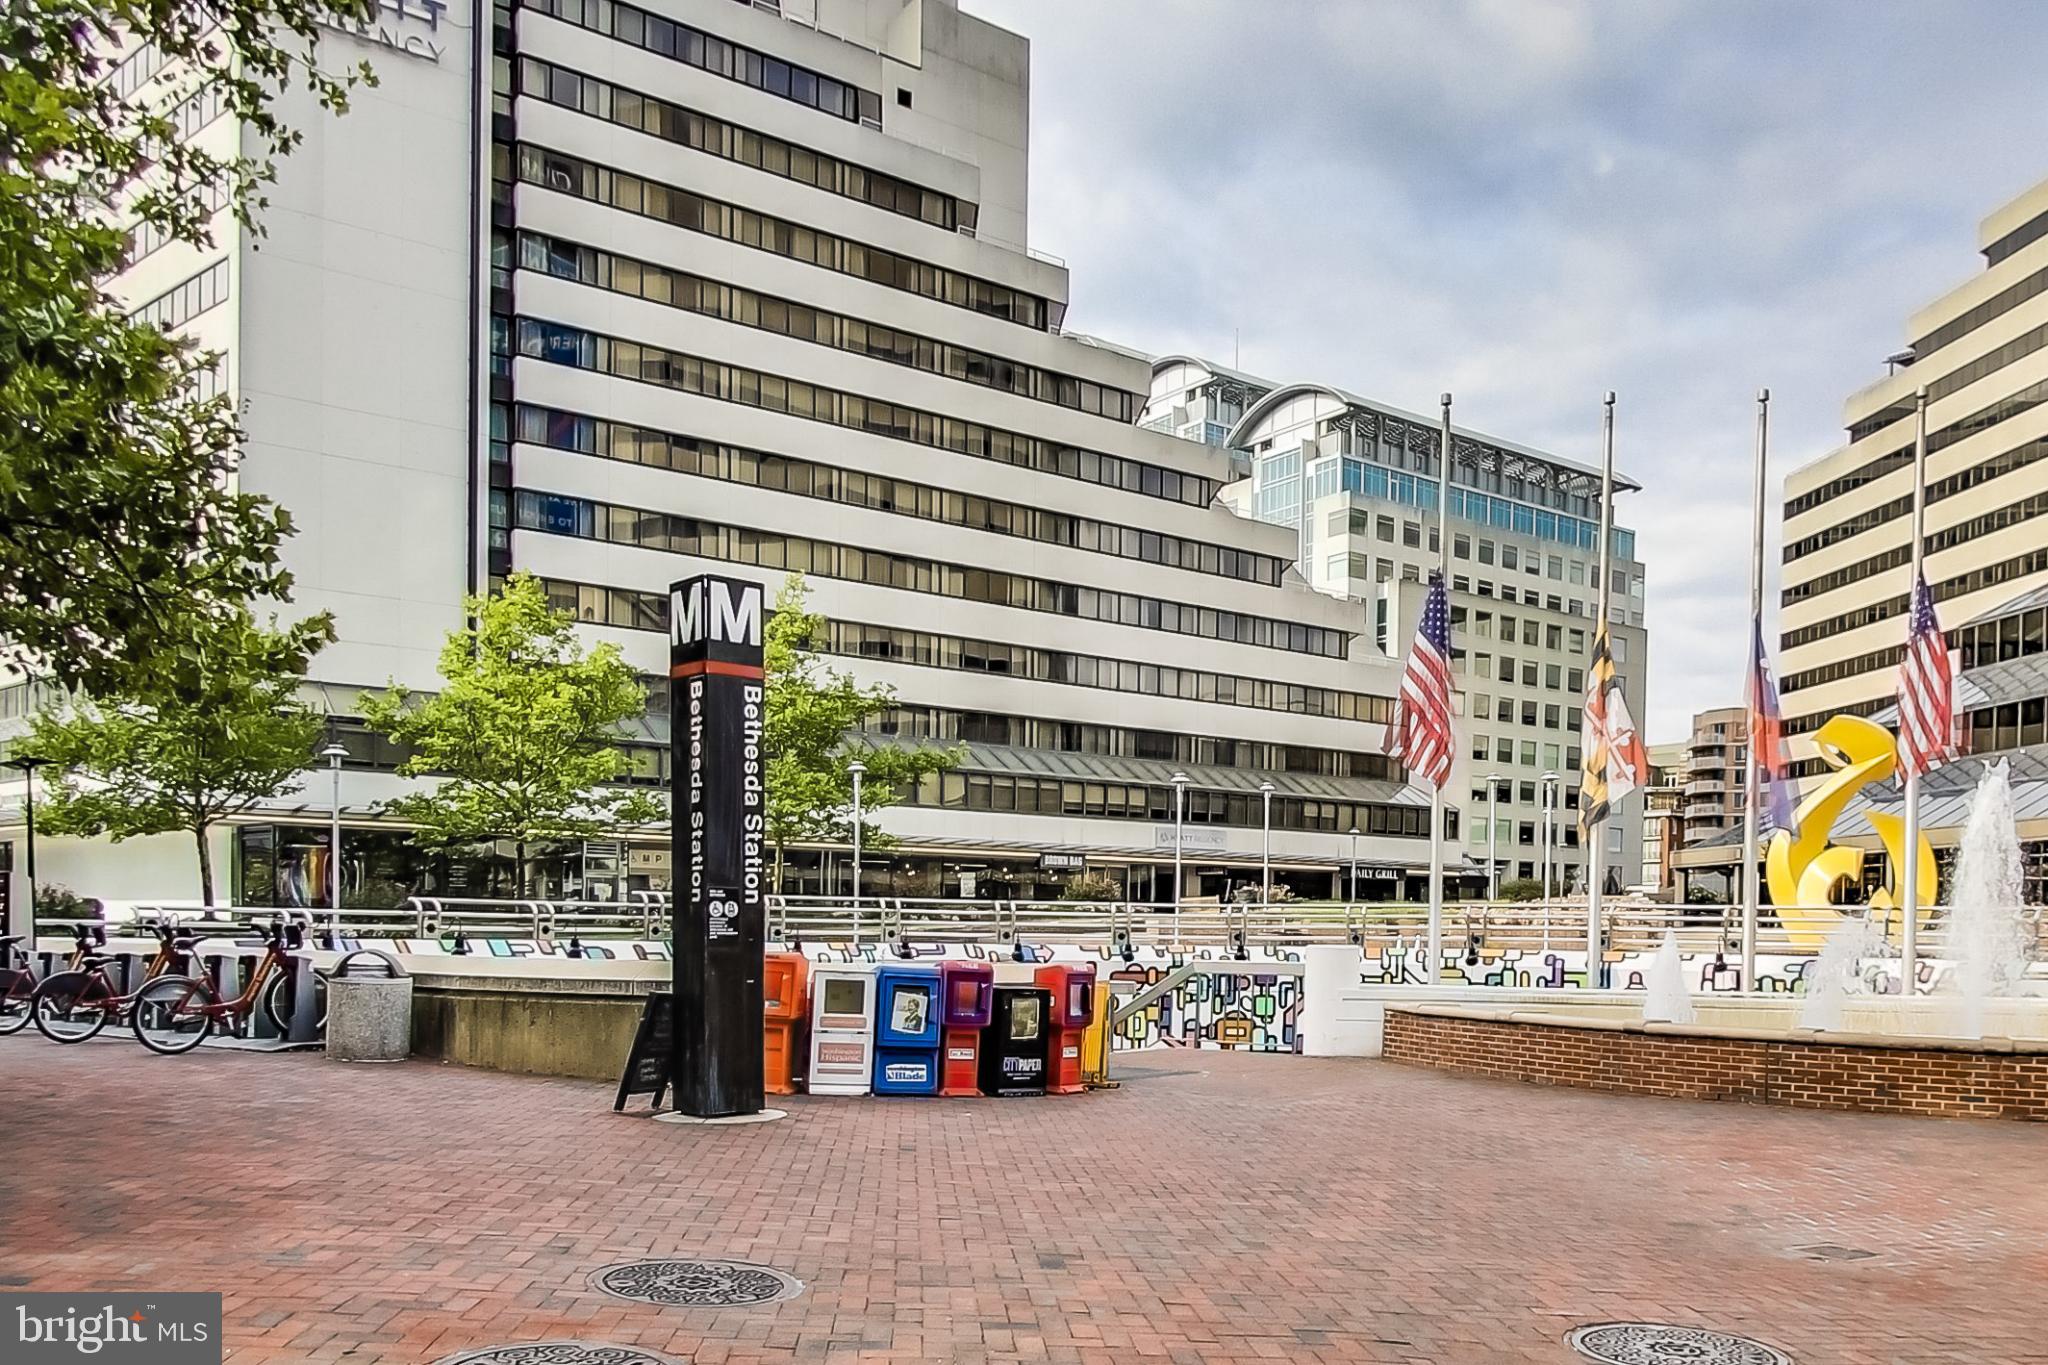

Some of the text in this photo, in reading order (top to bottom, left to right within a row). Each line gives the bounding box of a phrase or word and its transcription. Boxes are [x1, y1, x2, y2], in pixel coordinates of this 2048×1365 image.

[671, 582, 702, 646] M
[710, 580, 761, 646] M
[690, 681, 703, 902] Bethesda Station
[744, 686, 762, 904] Bethesda Station
[1045, 855, 1082, 866] BROWN BAG
[1375, 869, 1398, 879] GRILL
[895, 1071, 925, 1080] Blade
